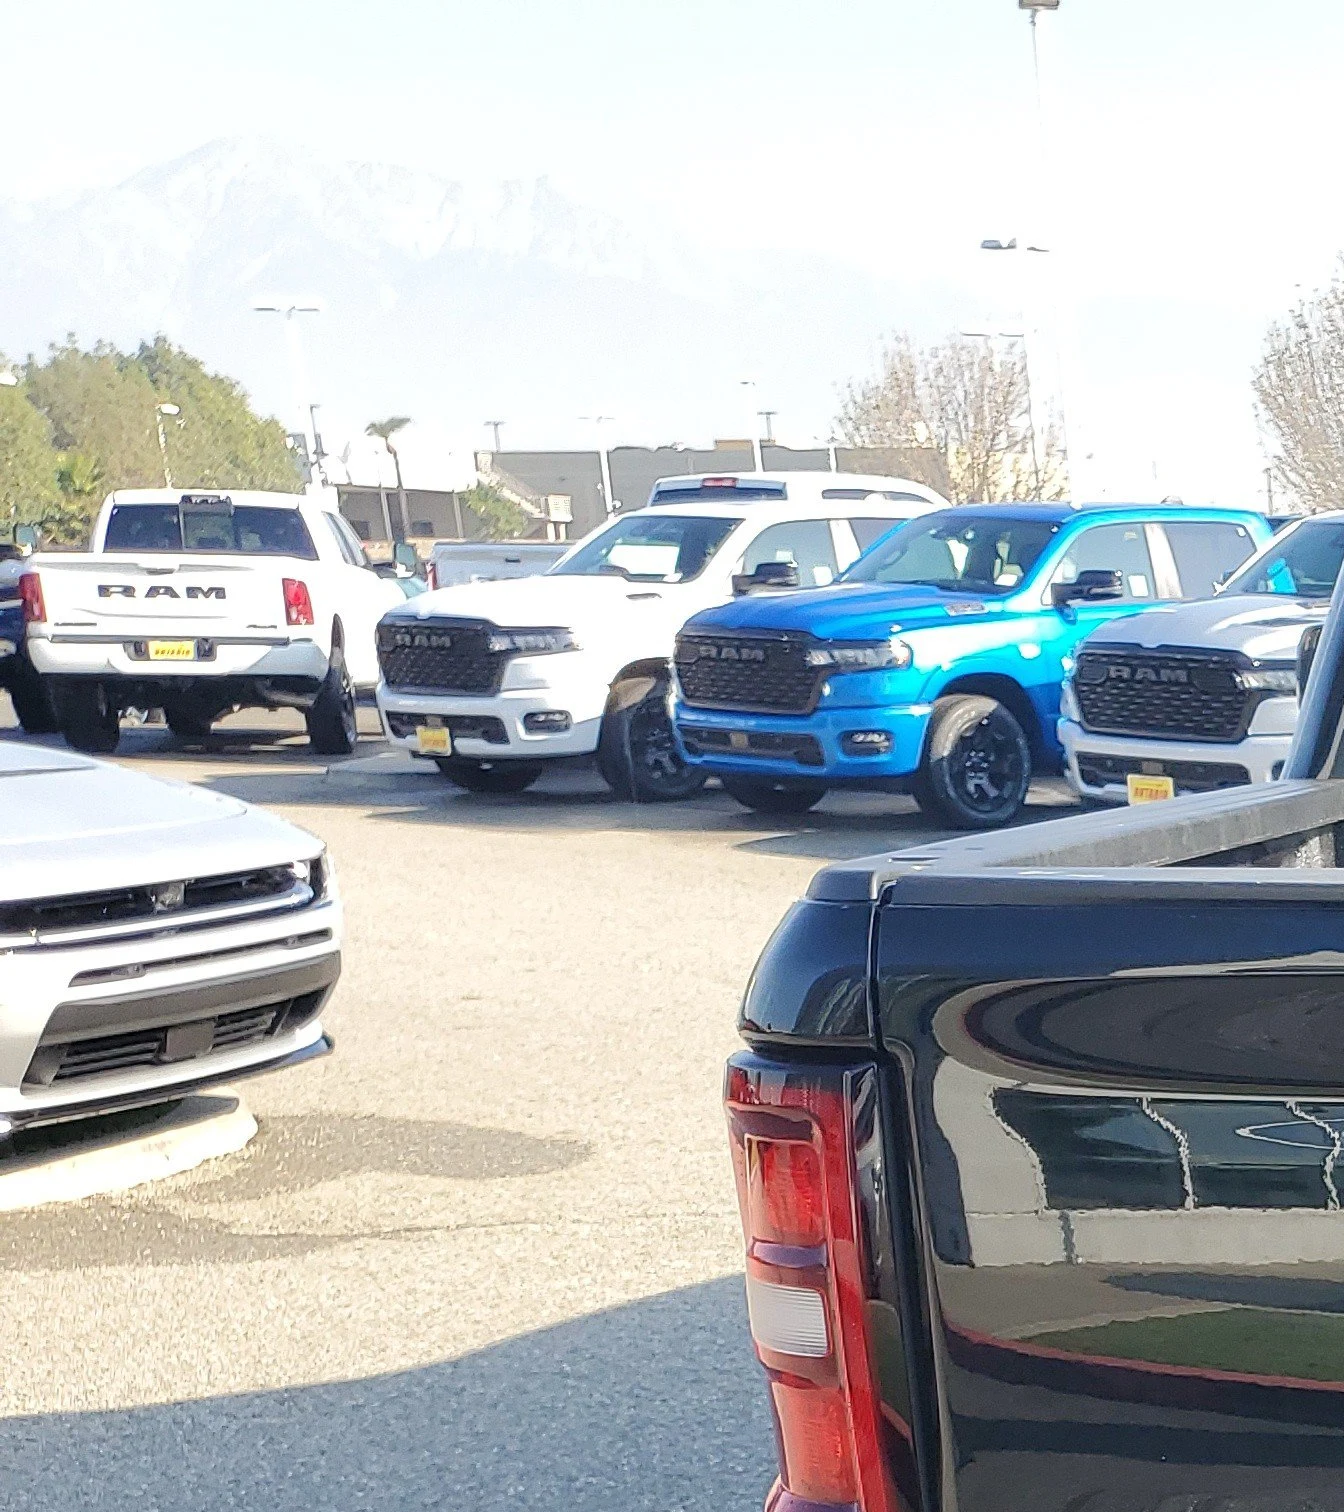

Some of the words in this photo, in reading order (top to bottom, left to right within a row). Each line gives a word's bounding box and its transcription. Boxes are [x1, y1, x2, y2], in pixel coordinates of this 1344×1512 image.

[97, 584, 227, 600] RAM
[699, 645, 766, 662] RAM
[1107, 664, 1188, 683] RAM
